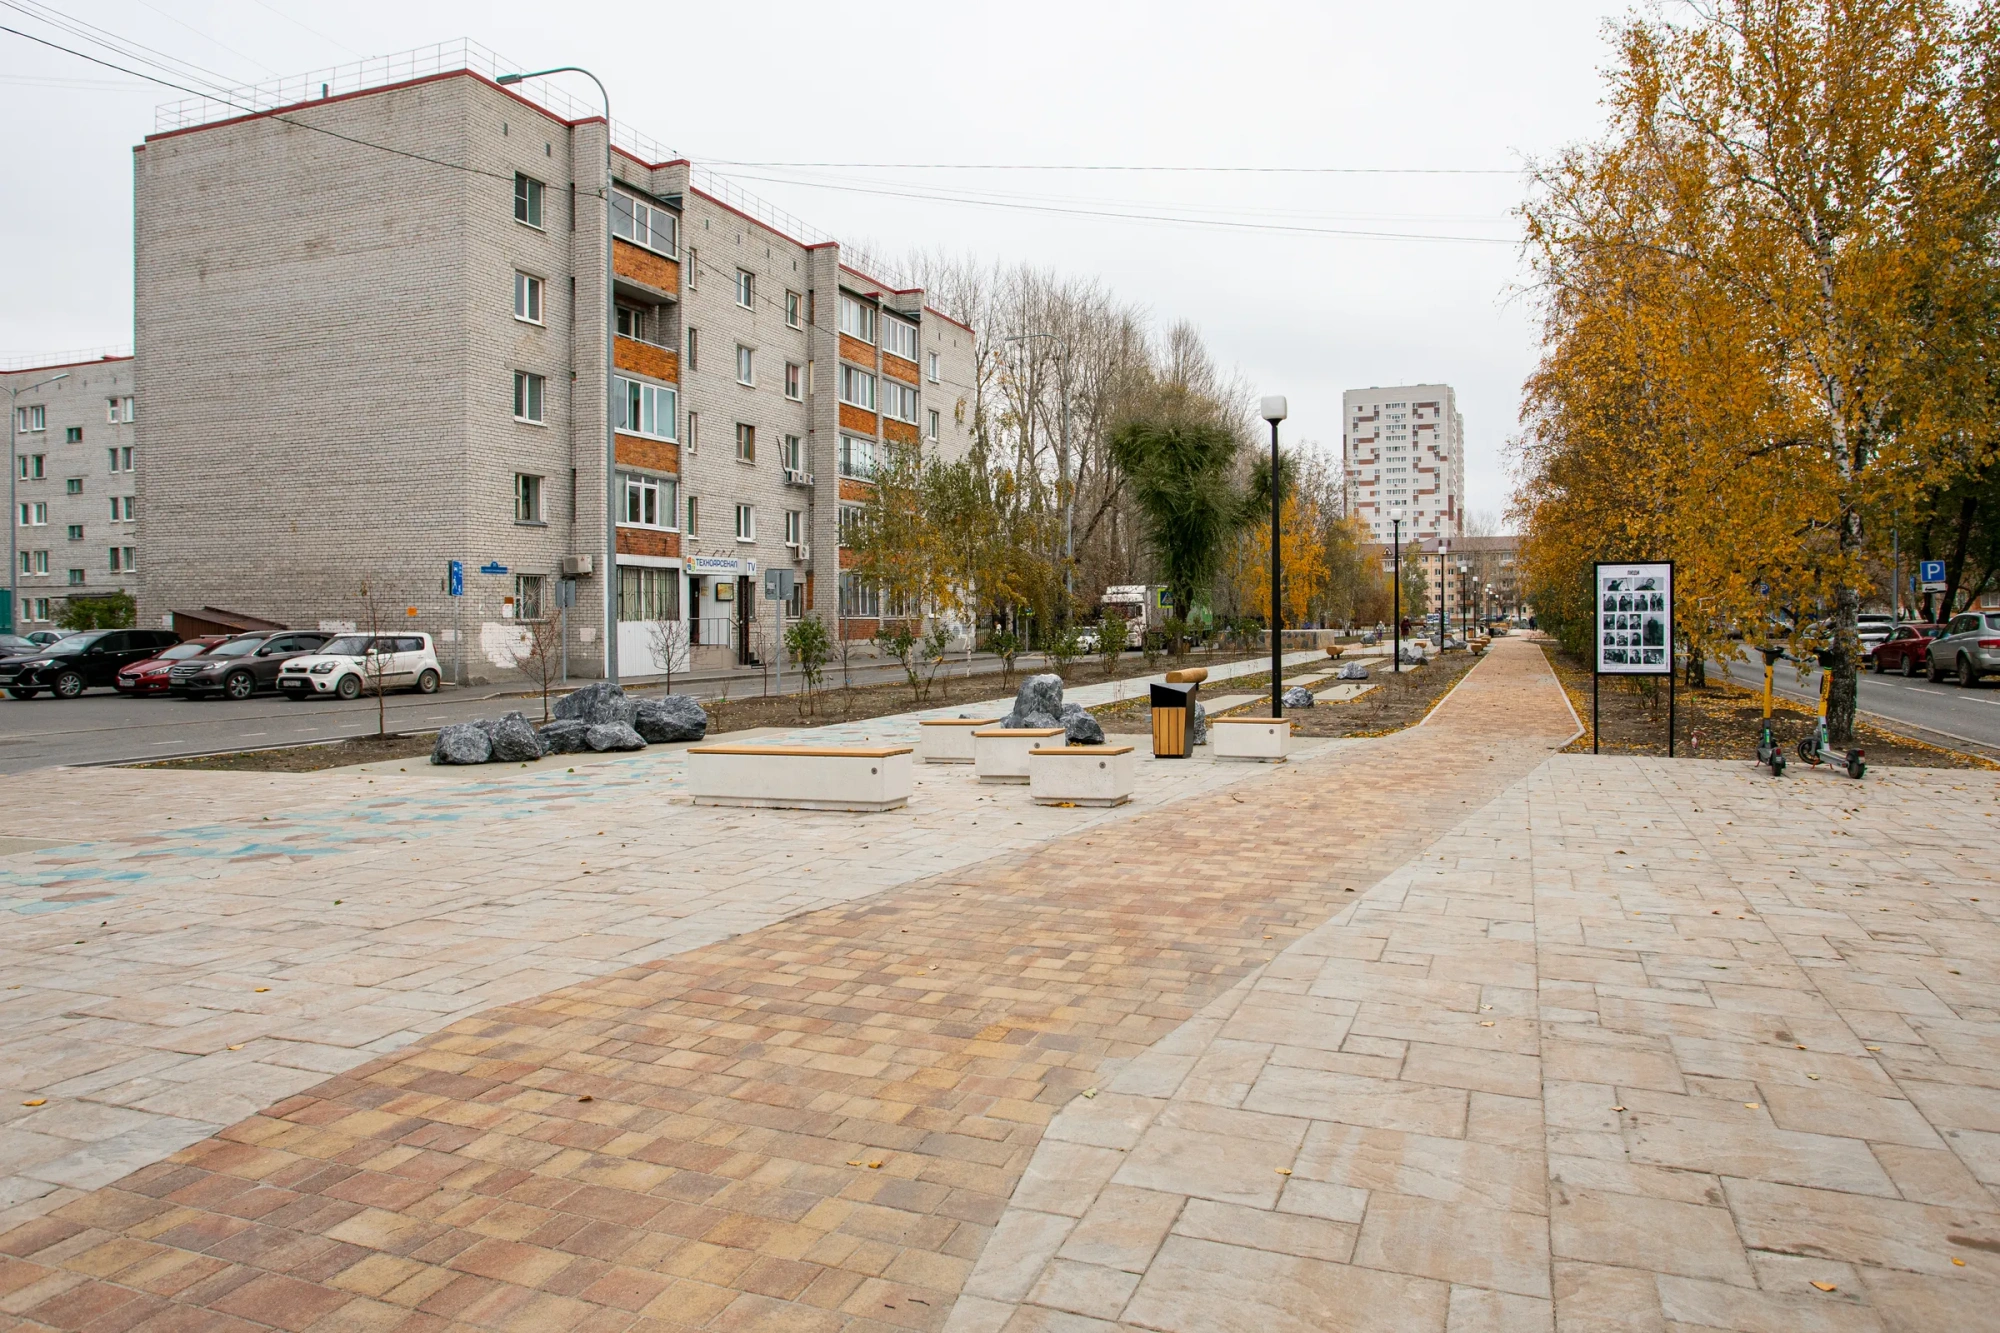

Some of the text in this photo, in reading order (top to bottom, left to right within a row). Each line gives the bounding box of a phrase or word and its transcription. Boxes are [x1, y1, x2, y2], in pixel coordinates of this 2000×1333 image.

[696, 558, 737, 568] ТЕХНОАРСЕНАЛ
[747, 562, 756, 571] TV
[1927, 563, 1940, 580] P
